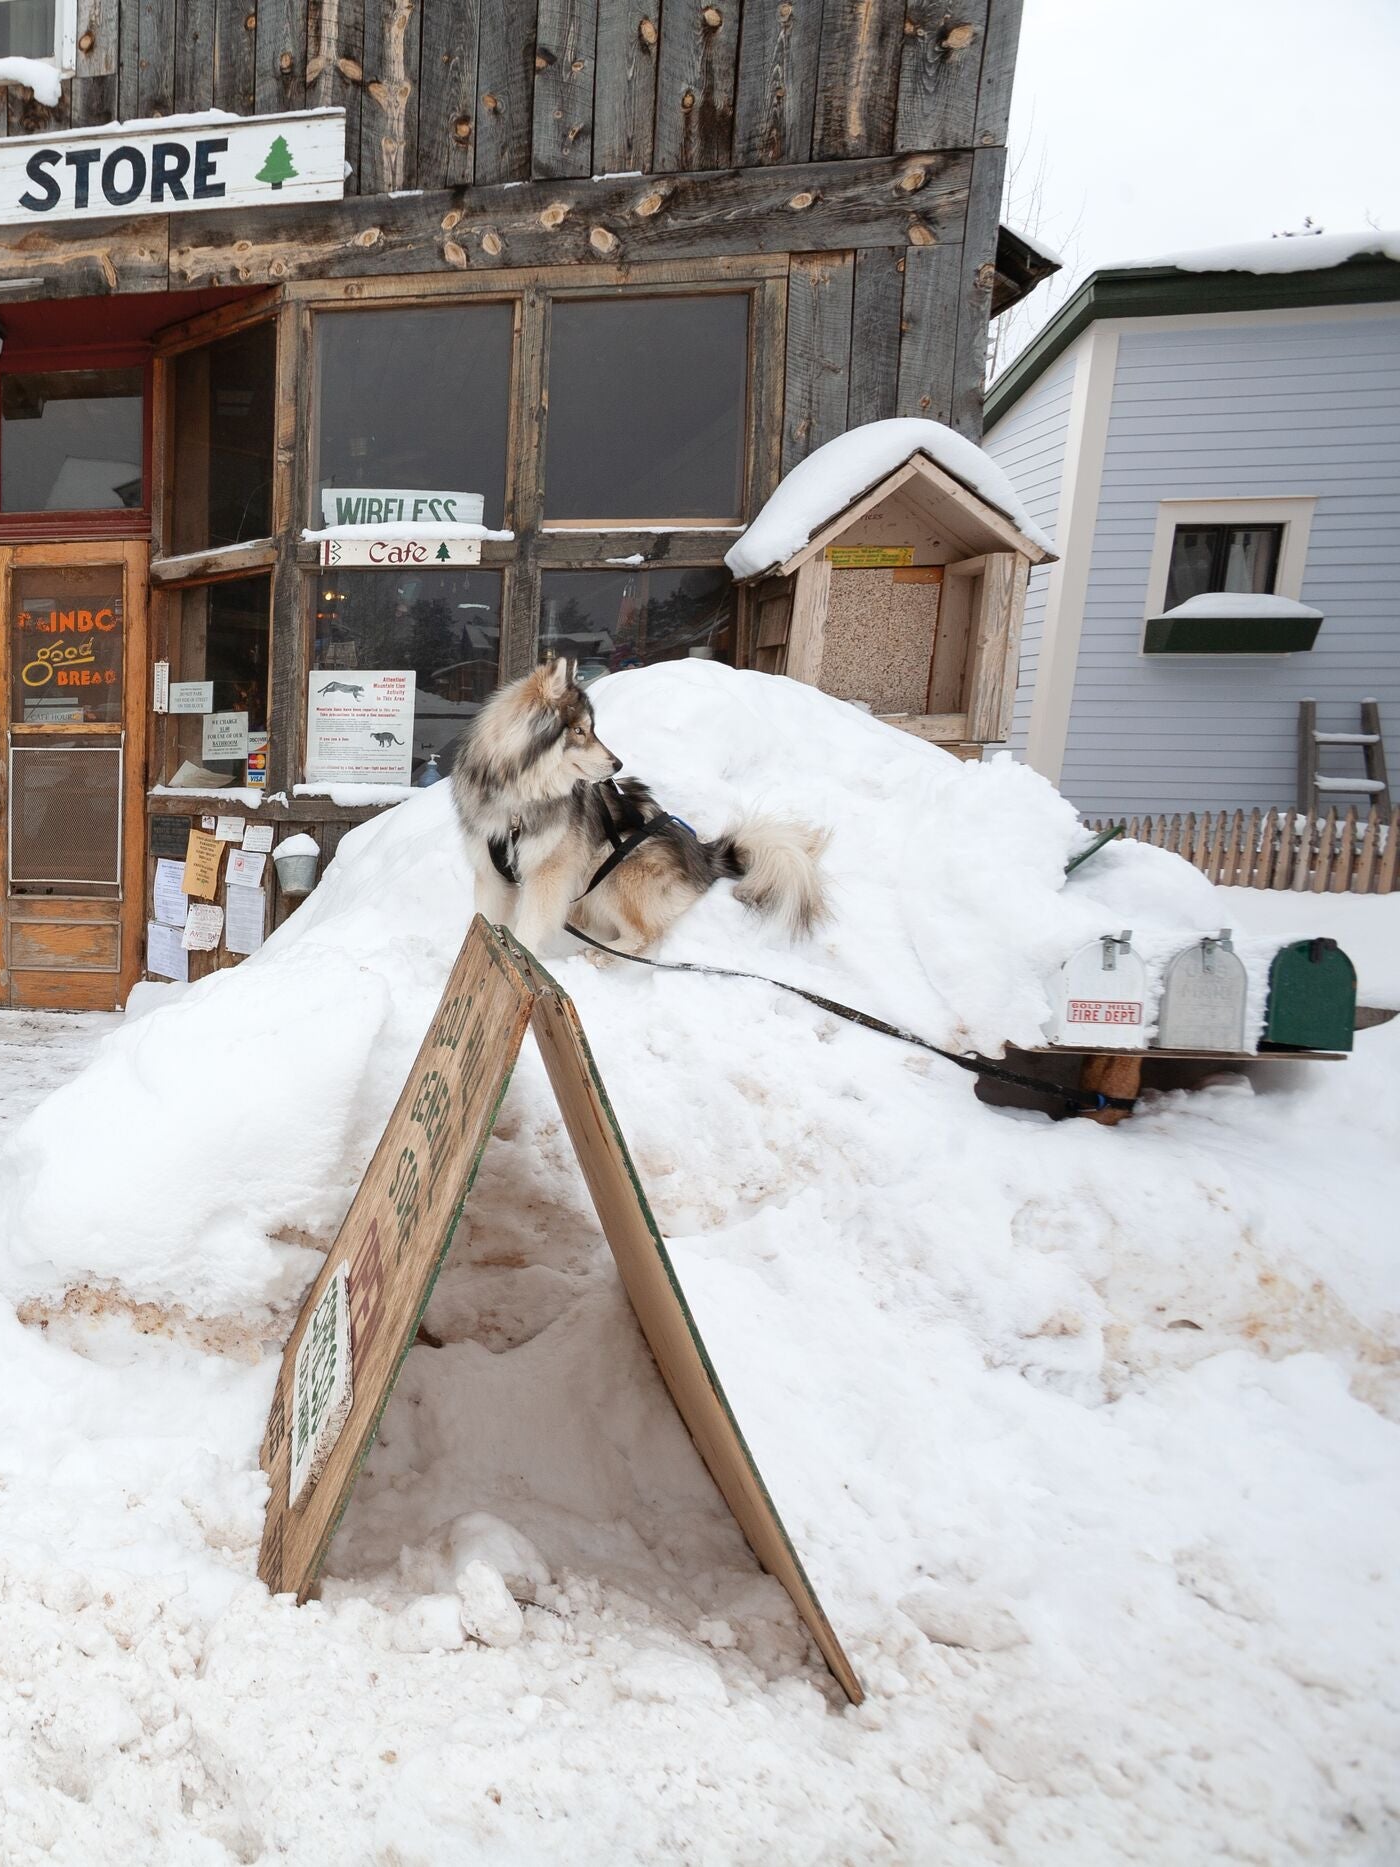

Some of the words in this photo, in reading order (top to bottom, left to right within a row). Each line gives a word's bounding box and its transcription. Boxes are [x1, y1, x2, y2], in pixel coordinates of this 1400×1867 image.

[18, 137, 229, 213] STORE
[336, 497, 458, 524] WIRELESS
[369, 541, 429, 564] Cafe
[22, 637, 95, 687] good
[1072, 1010, 1100, 1021] FIRE
[432, 996, 473, 1051] GOLD
[459, 1011, 486, 1137] HILL
[410, 1070, 453, 1212] GENERAL
[388, 1146, 420, 1267] STORE
[347, 1216, 386, 1379] OPEN
[298, 1342, 310, 1399] COLD
[311, 1274, 338, 1436] ESPRESSO
[295, 1387, 309, 1468] DRINKS
